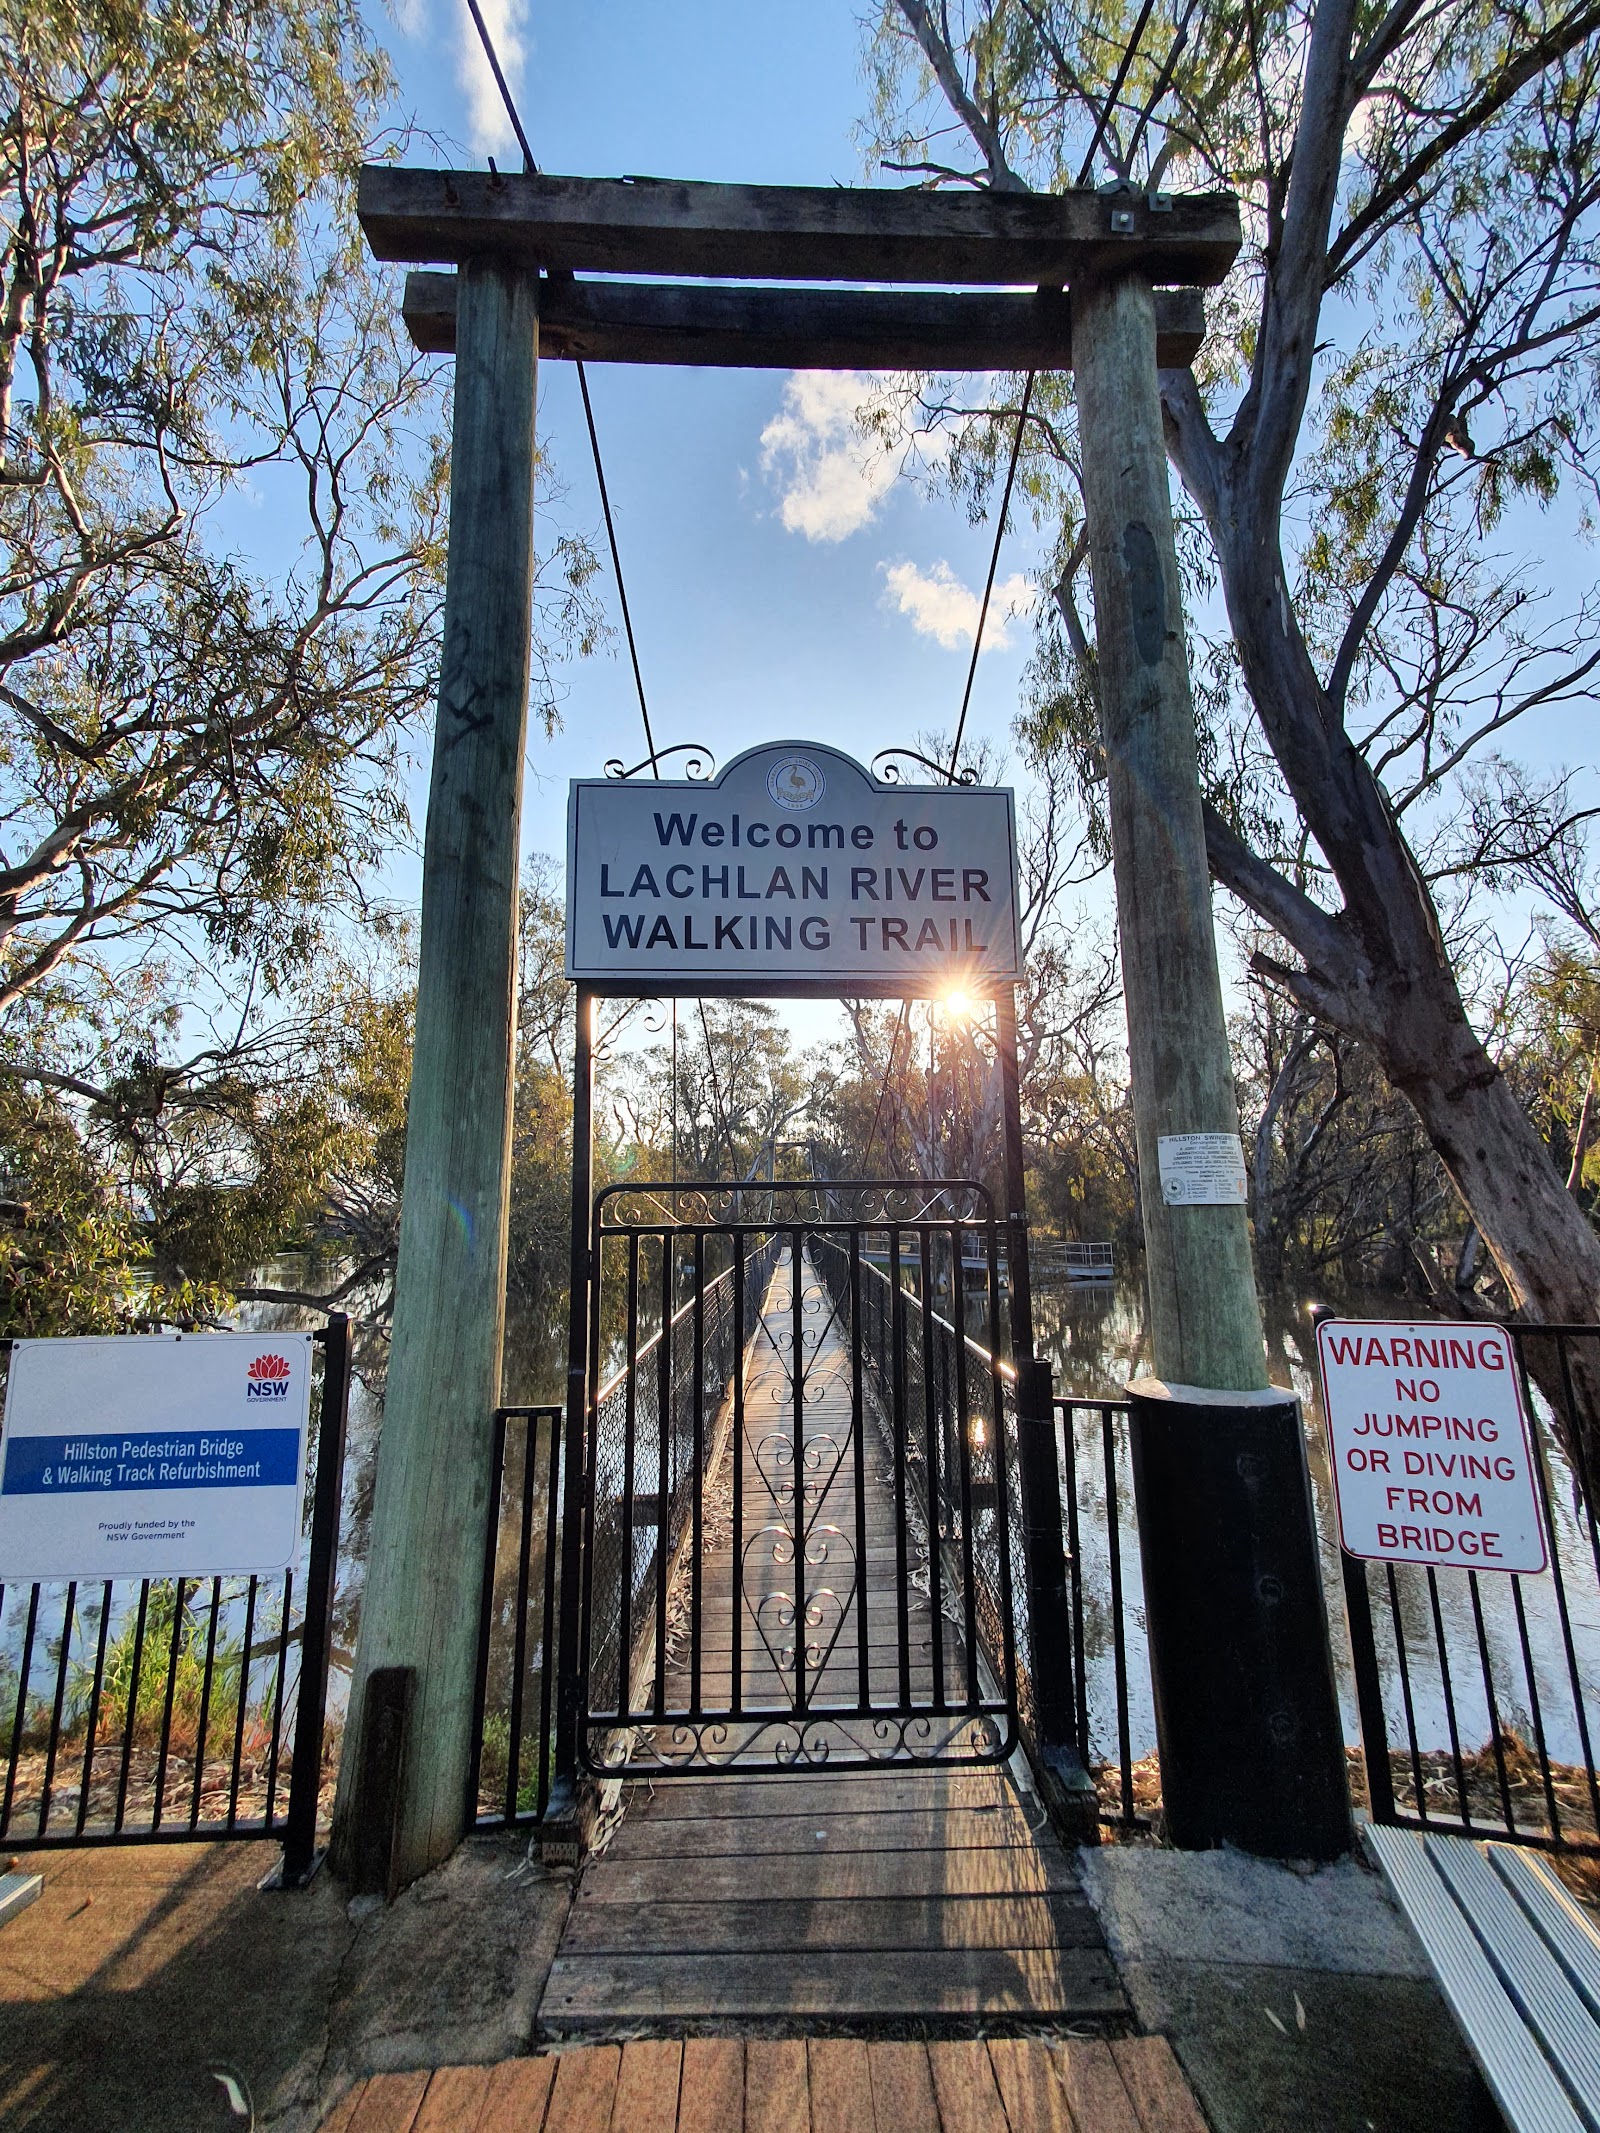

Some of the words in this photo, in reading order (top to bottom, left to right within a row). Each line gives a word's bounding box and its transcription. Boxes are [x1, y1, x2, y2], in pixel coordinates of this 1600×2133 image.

[653, 812, 875, 850] Welcome
[893, 817, 939, 851] to
[600, 862, 829, 901] LACHLAN
[850, 866, 992, 902] RIVER
[602, 914, 831, 951] WALKING
[850, 916, 989, 952] TRAIL
[1327, 1336, 1505, 1371] WARNING
[247, 1381, 290, 1397] NSW
[1395, 1378, 1440, 1403] NO
[1353, 1413, 1499, 1443] JUMPING
[64, 1441, 118, 1461] Hillston
[121, 1438, 196, 1459] Pedestrian
[199, 1438, 244, 1459] Bridge
[42, 1468, 53, 1485] &
[58, 1465, 113, 1486] Walking
[117, 1463, 155, 1482] Track
[159, 1460, 261, 1481] Refurbishment
[1347, 1448, 1391, 1474] OR
[1404, 1451, 1515, 1482] DIVING
[1386, 1487, 1483, 1518] FROM
[98, 1520, 132, 1532] Proudly
[134, 1519, 166, 1529] funded
[167, 1519, 180, 1530] by
[181, 1518, 196, 1528] the
[106, 1532, 129, 1542] NSW
[131, 1531, 185, 1541] Government
[1377, 1523, 1503, 1558] BRIDGE
